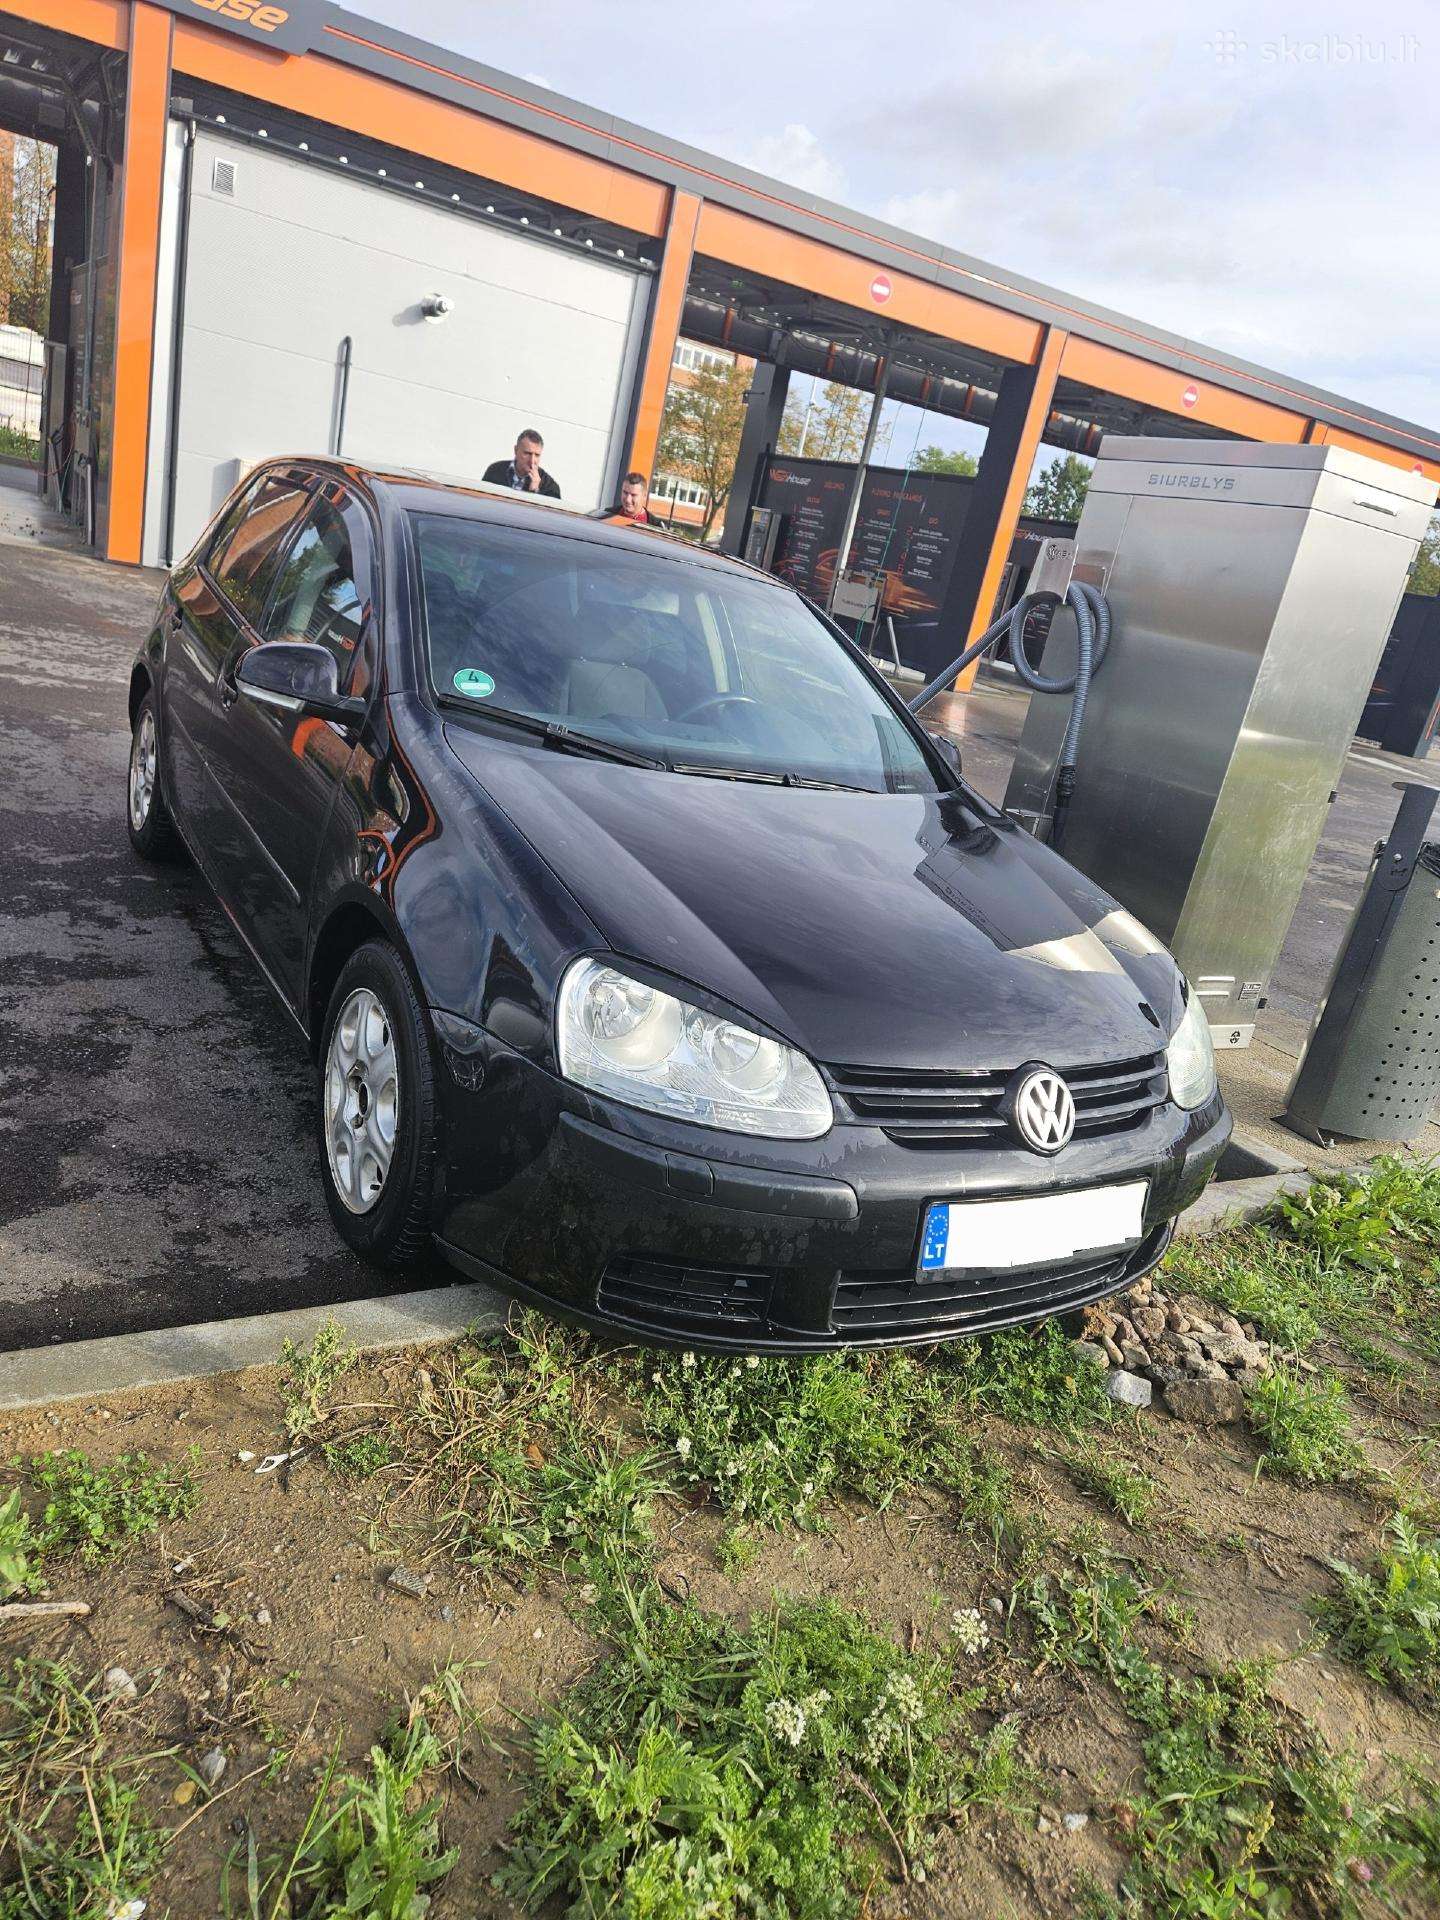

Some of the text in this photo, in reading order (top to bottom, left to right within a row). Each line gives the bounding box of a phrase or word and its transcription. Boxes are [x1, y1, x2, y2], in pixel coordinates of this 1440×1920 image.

[1147, 473, 1236, 490] SIURBLYS
[468, 670, 479, 683] 4
[924, 1243, 945, 1259] LT
